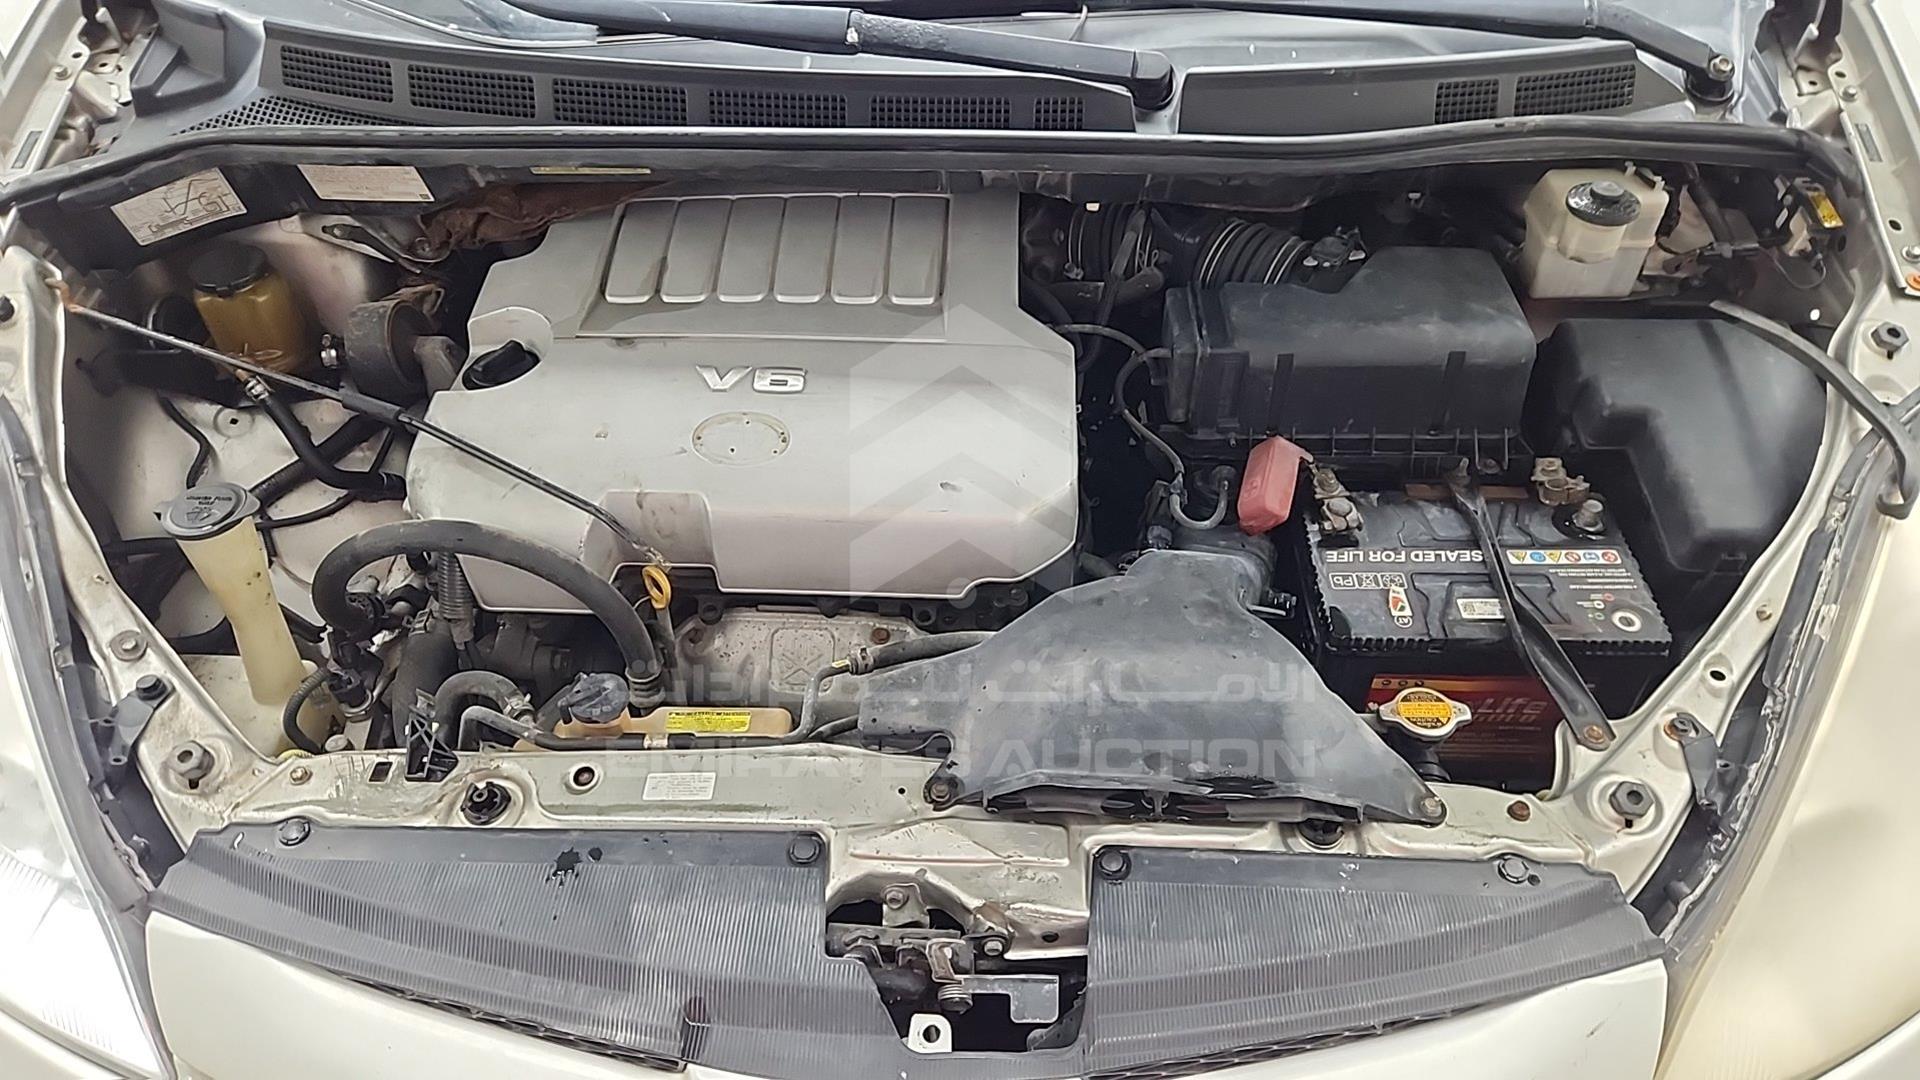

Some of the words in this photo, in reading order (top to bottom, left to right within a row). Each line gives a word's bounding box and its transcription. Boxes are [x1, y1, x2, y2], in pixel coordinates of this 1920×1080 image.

[695, 364, 806, 393] V6
[1326, 550, 1364, 563] LIFE
[1369, 550, 1406, 562] FOR
[1411, 550, 1484, 562] SEALED
[1333, 576, 1353, 586] Pb
